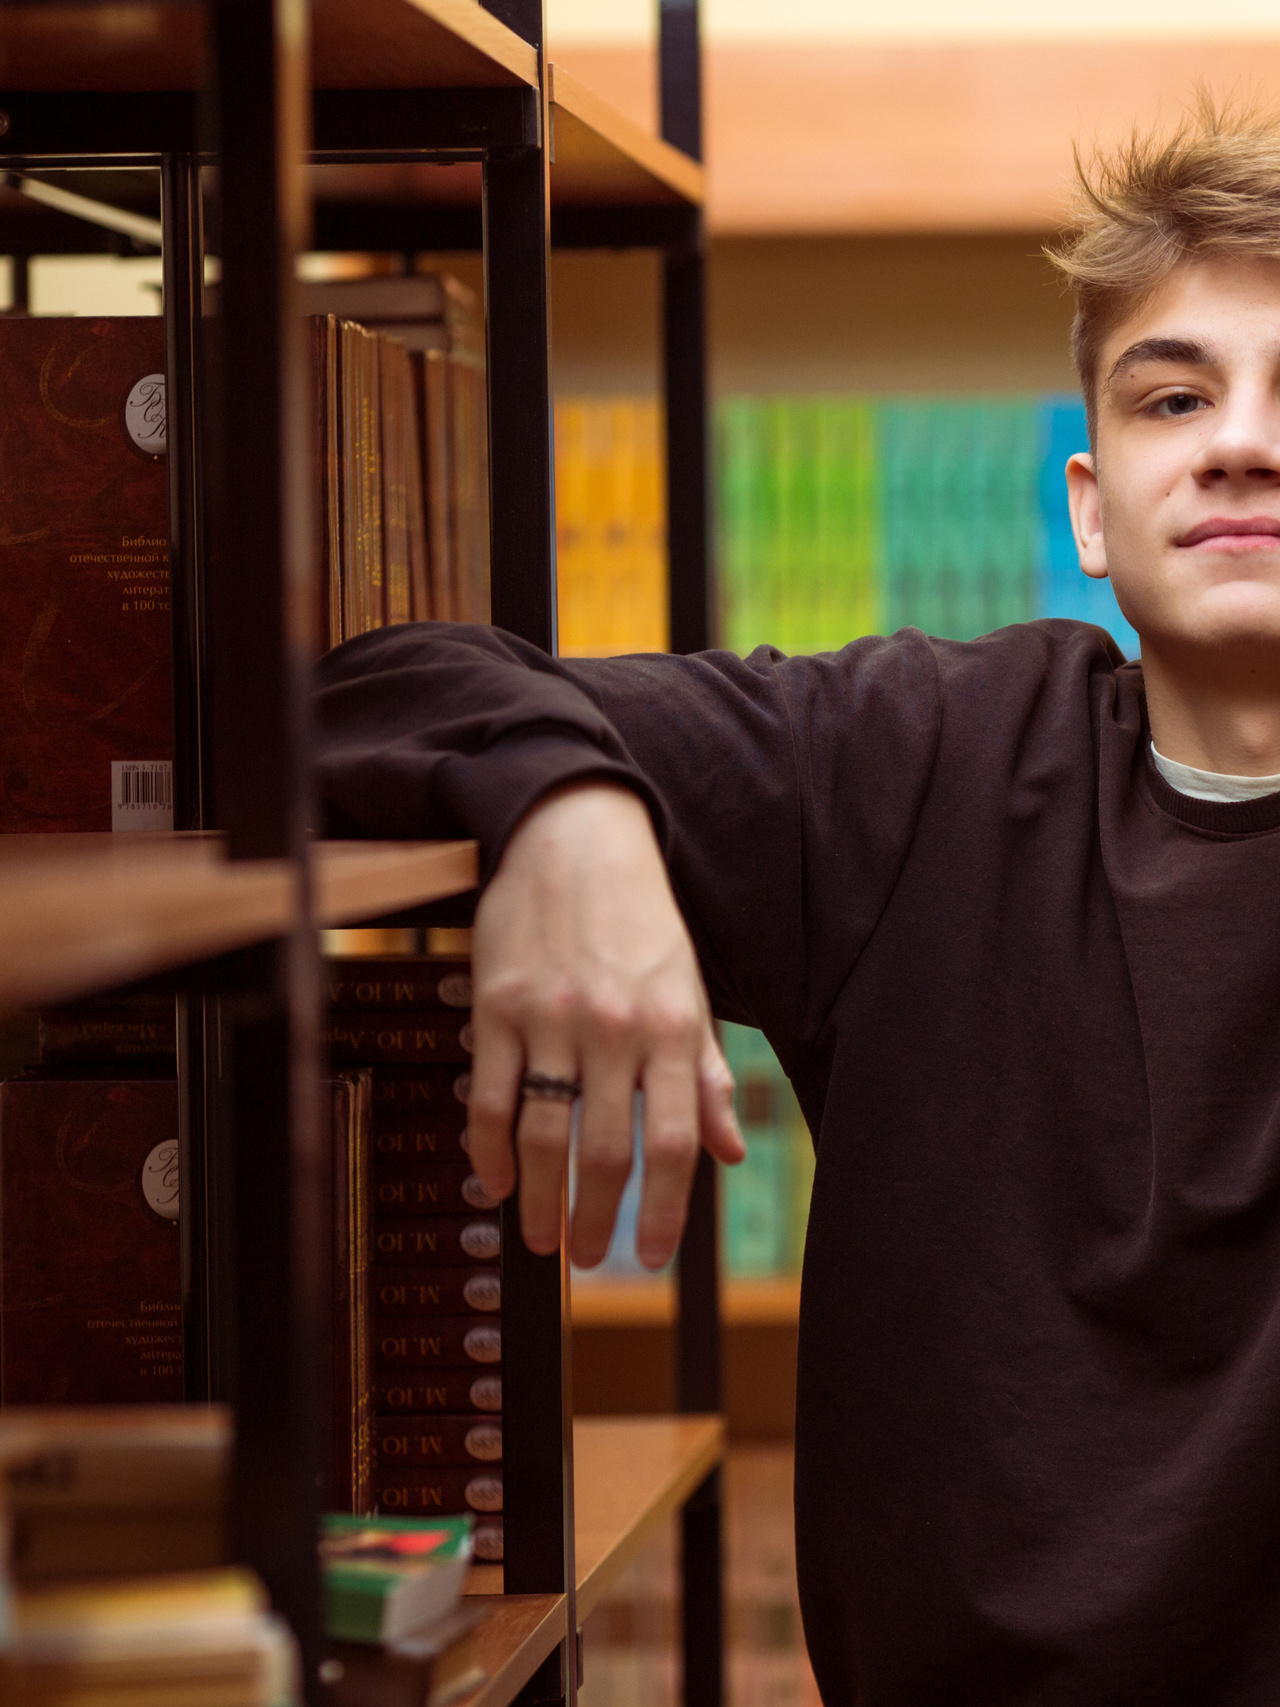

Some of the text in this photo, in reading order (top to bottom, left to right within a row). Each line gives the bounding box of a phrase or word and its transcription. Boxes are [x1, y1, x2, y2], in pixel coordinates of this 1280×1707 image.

[69, 552, 160, 564] отечественной
[122, 602, 129, 611] в
[134, 600, 155, 611] 100
[122, 764, 139, 772] ISBN
[87, 1318, 179, 1329] отечественной
[152, 1365, 174, 1376] 100
